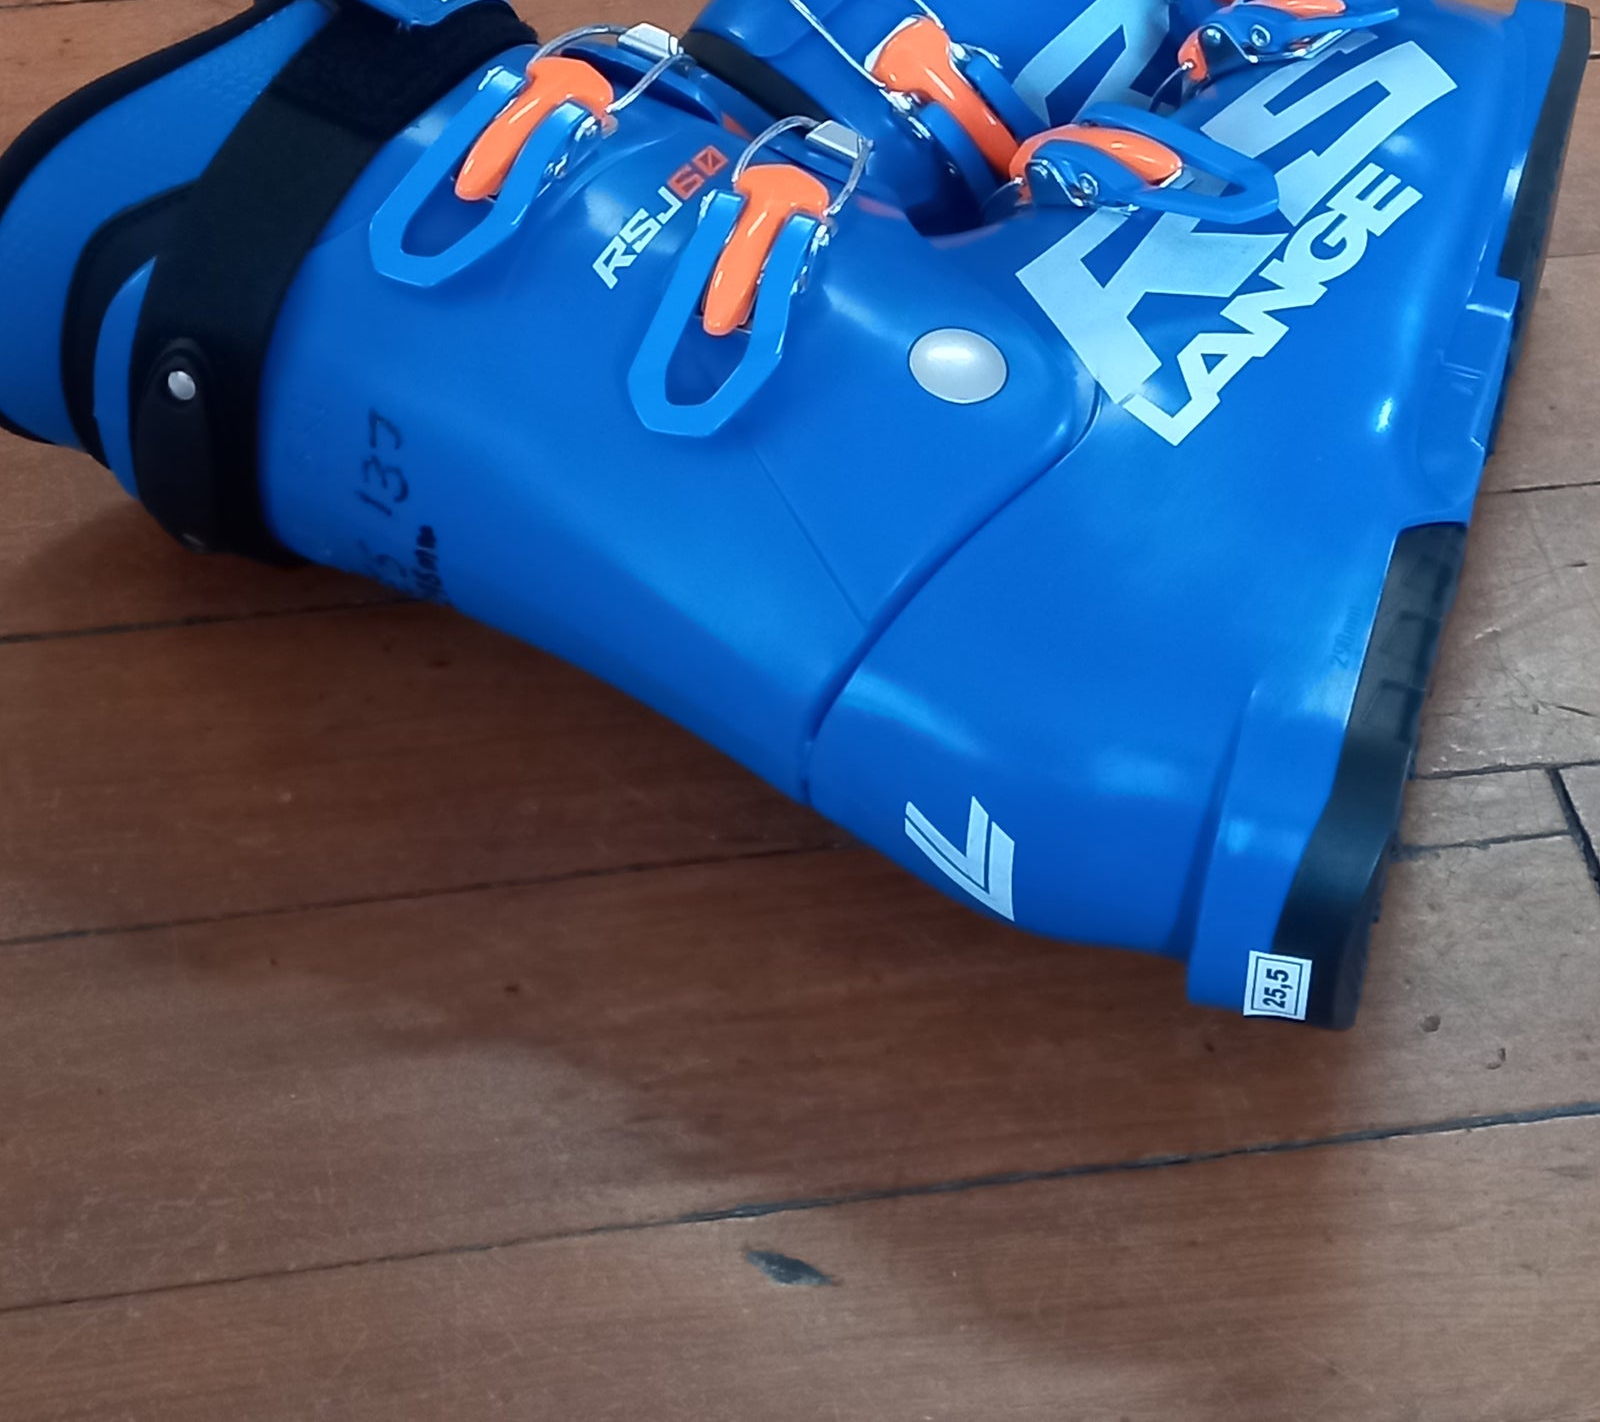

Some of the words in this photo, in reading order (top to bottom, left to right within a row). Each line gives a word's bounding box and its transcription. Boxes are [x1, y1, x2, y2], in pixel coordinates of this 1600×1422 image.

[592, 145, 729, 290] RSJ60
[1122, 161, 1424, 447] LANGE
[1261, 968, 1294, 1010] 25,5
